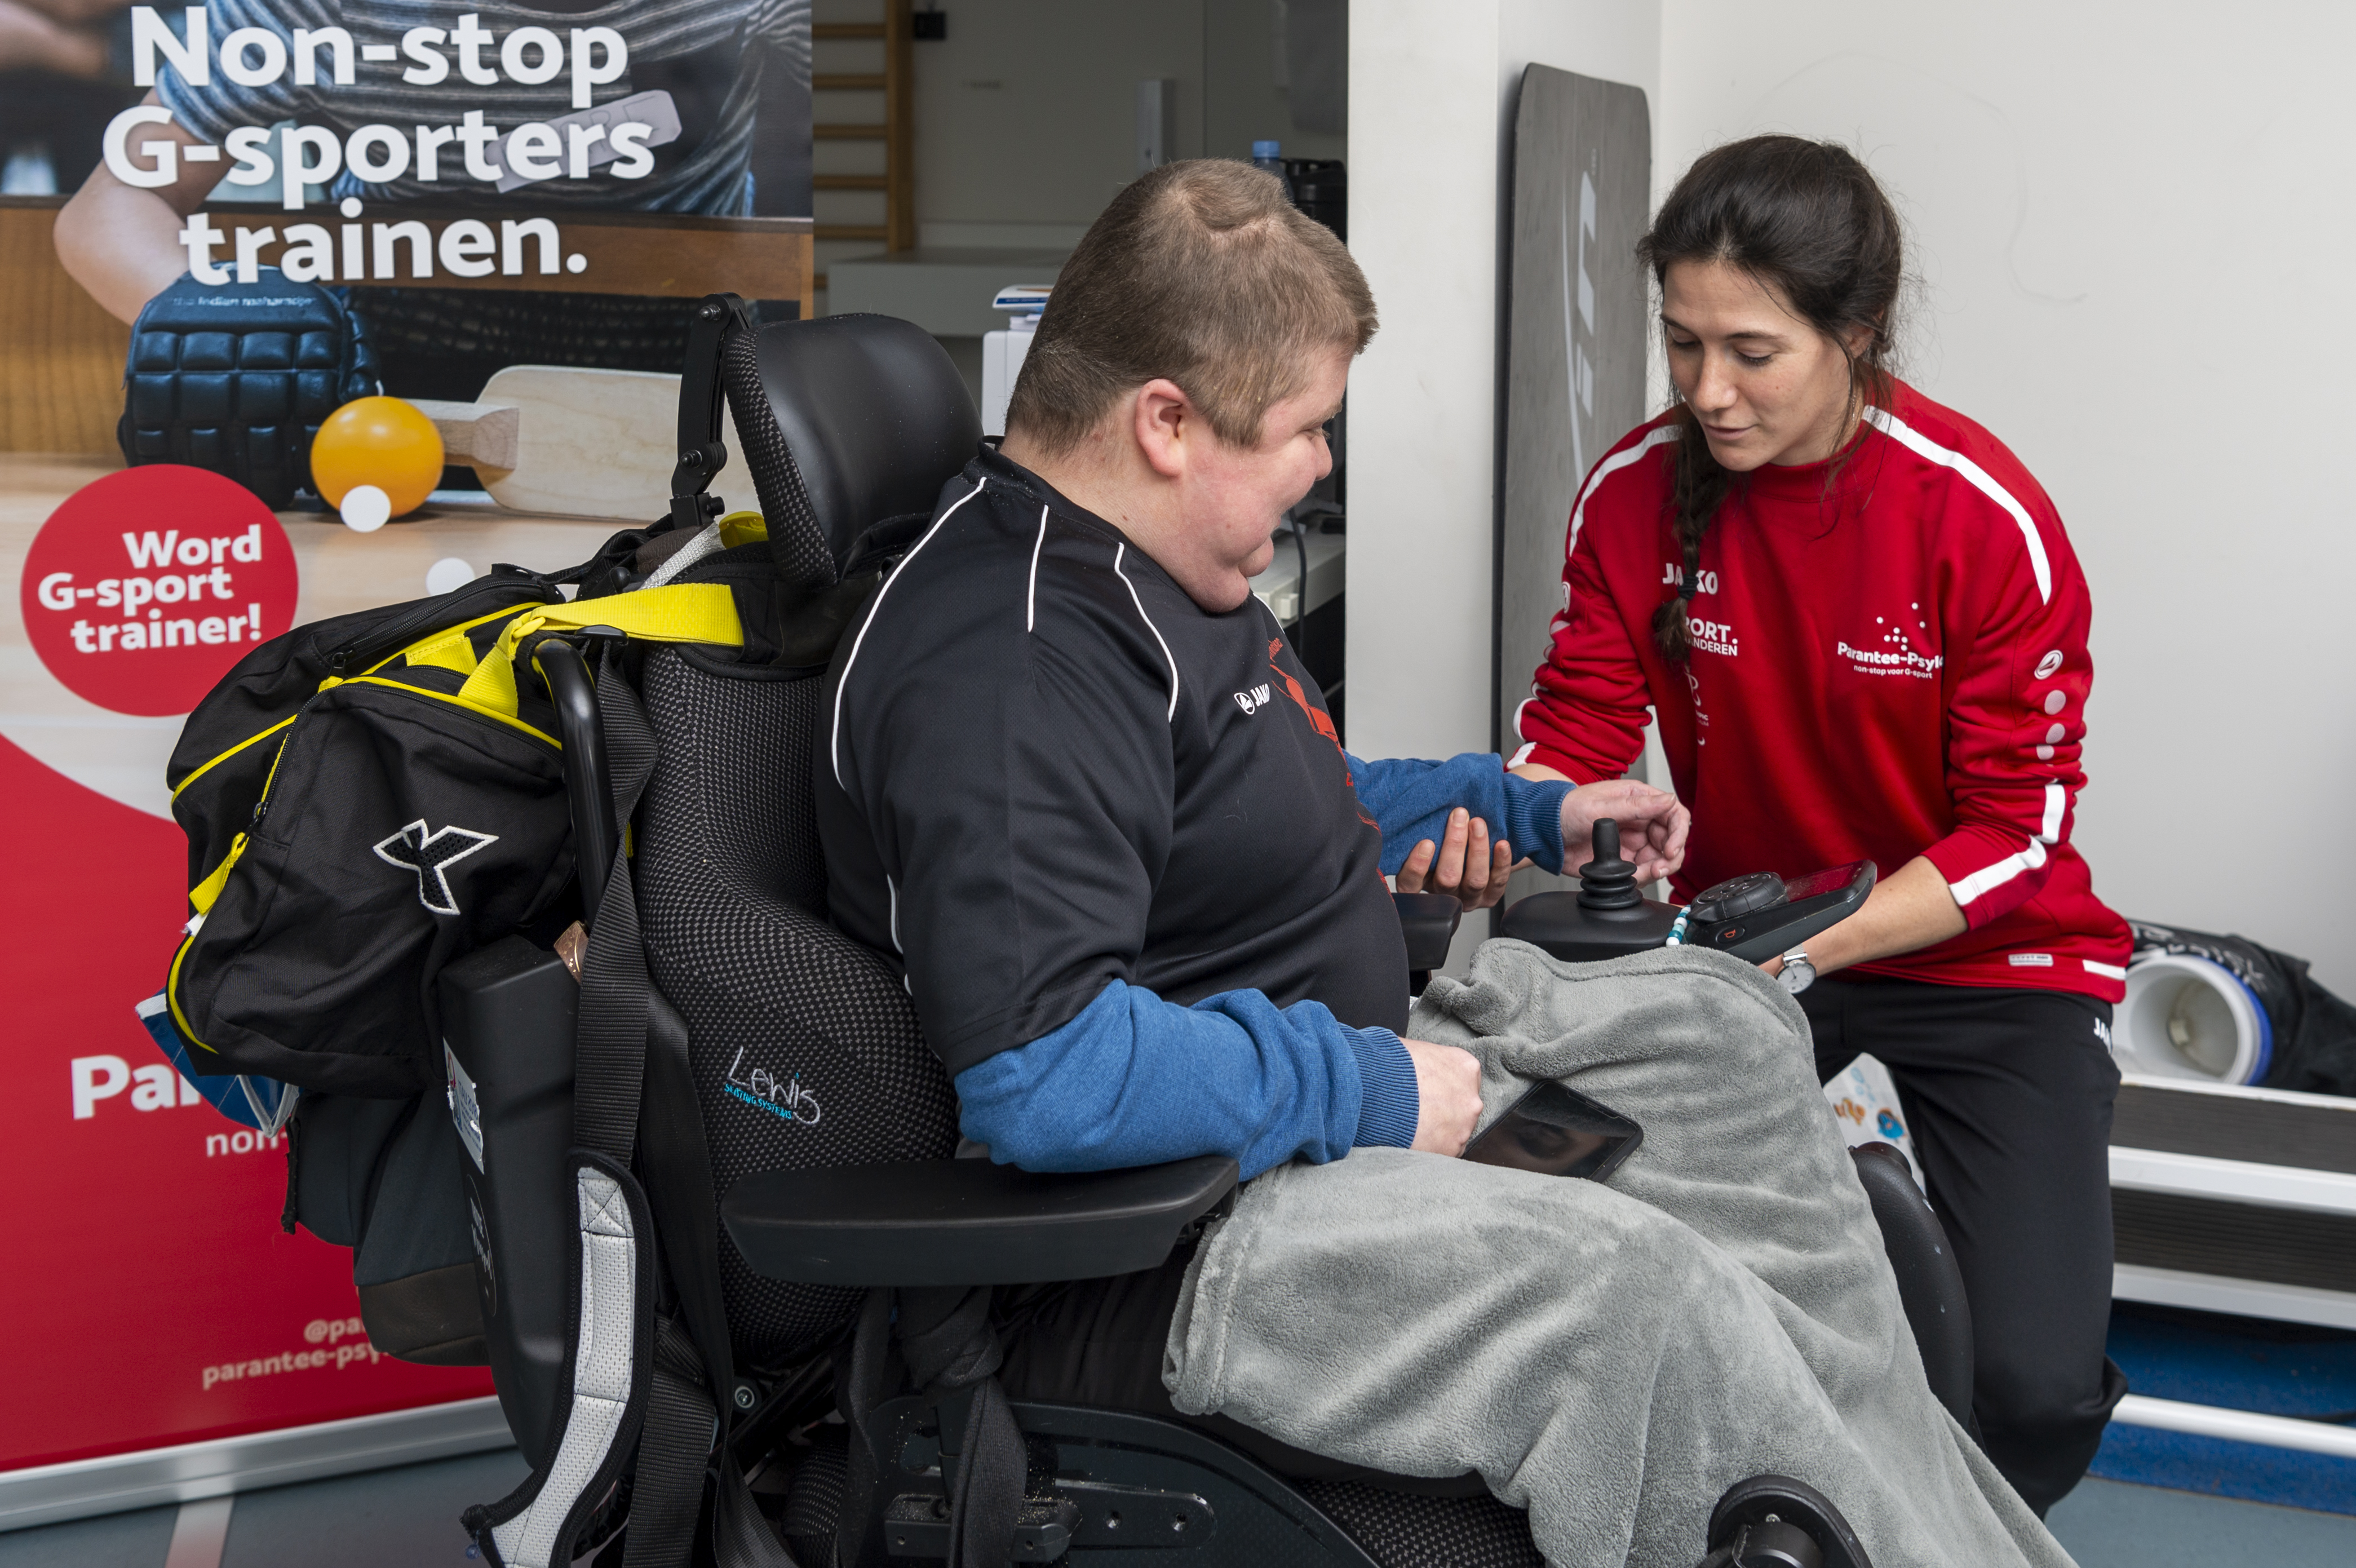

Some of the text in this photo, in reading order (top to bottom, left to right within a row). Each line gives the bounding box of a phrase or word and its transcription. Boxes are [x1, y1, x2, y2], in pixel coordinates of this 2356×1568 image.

[131, 6, 628, 109] Non-stop
[103, 105, 655, 209] G-sporters
[179, 197, 587, 285] trainen.
[122, 524, 262, 569] Word
[38, 566, 234, 617] G-sport
[1662, 562, 1718, 595] JAKO
[70, 603, 262, 653] trainer!
[1250, 683, 1270, 707] JAKO
[1854, 665, 1886, 676] non-stop
[1905, 668, 1933, 679] G-sport
[724, 1083, 792, 1120] SEATING SYSTEMS
[202, 1341, 388, 1391] parantee-psy
